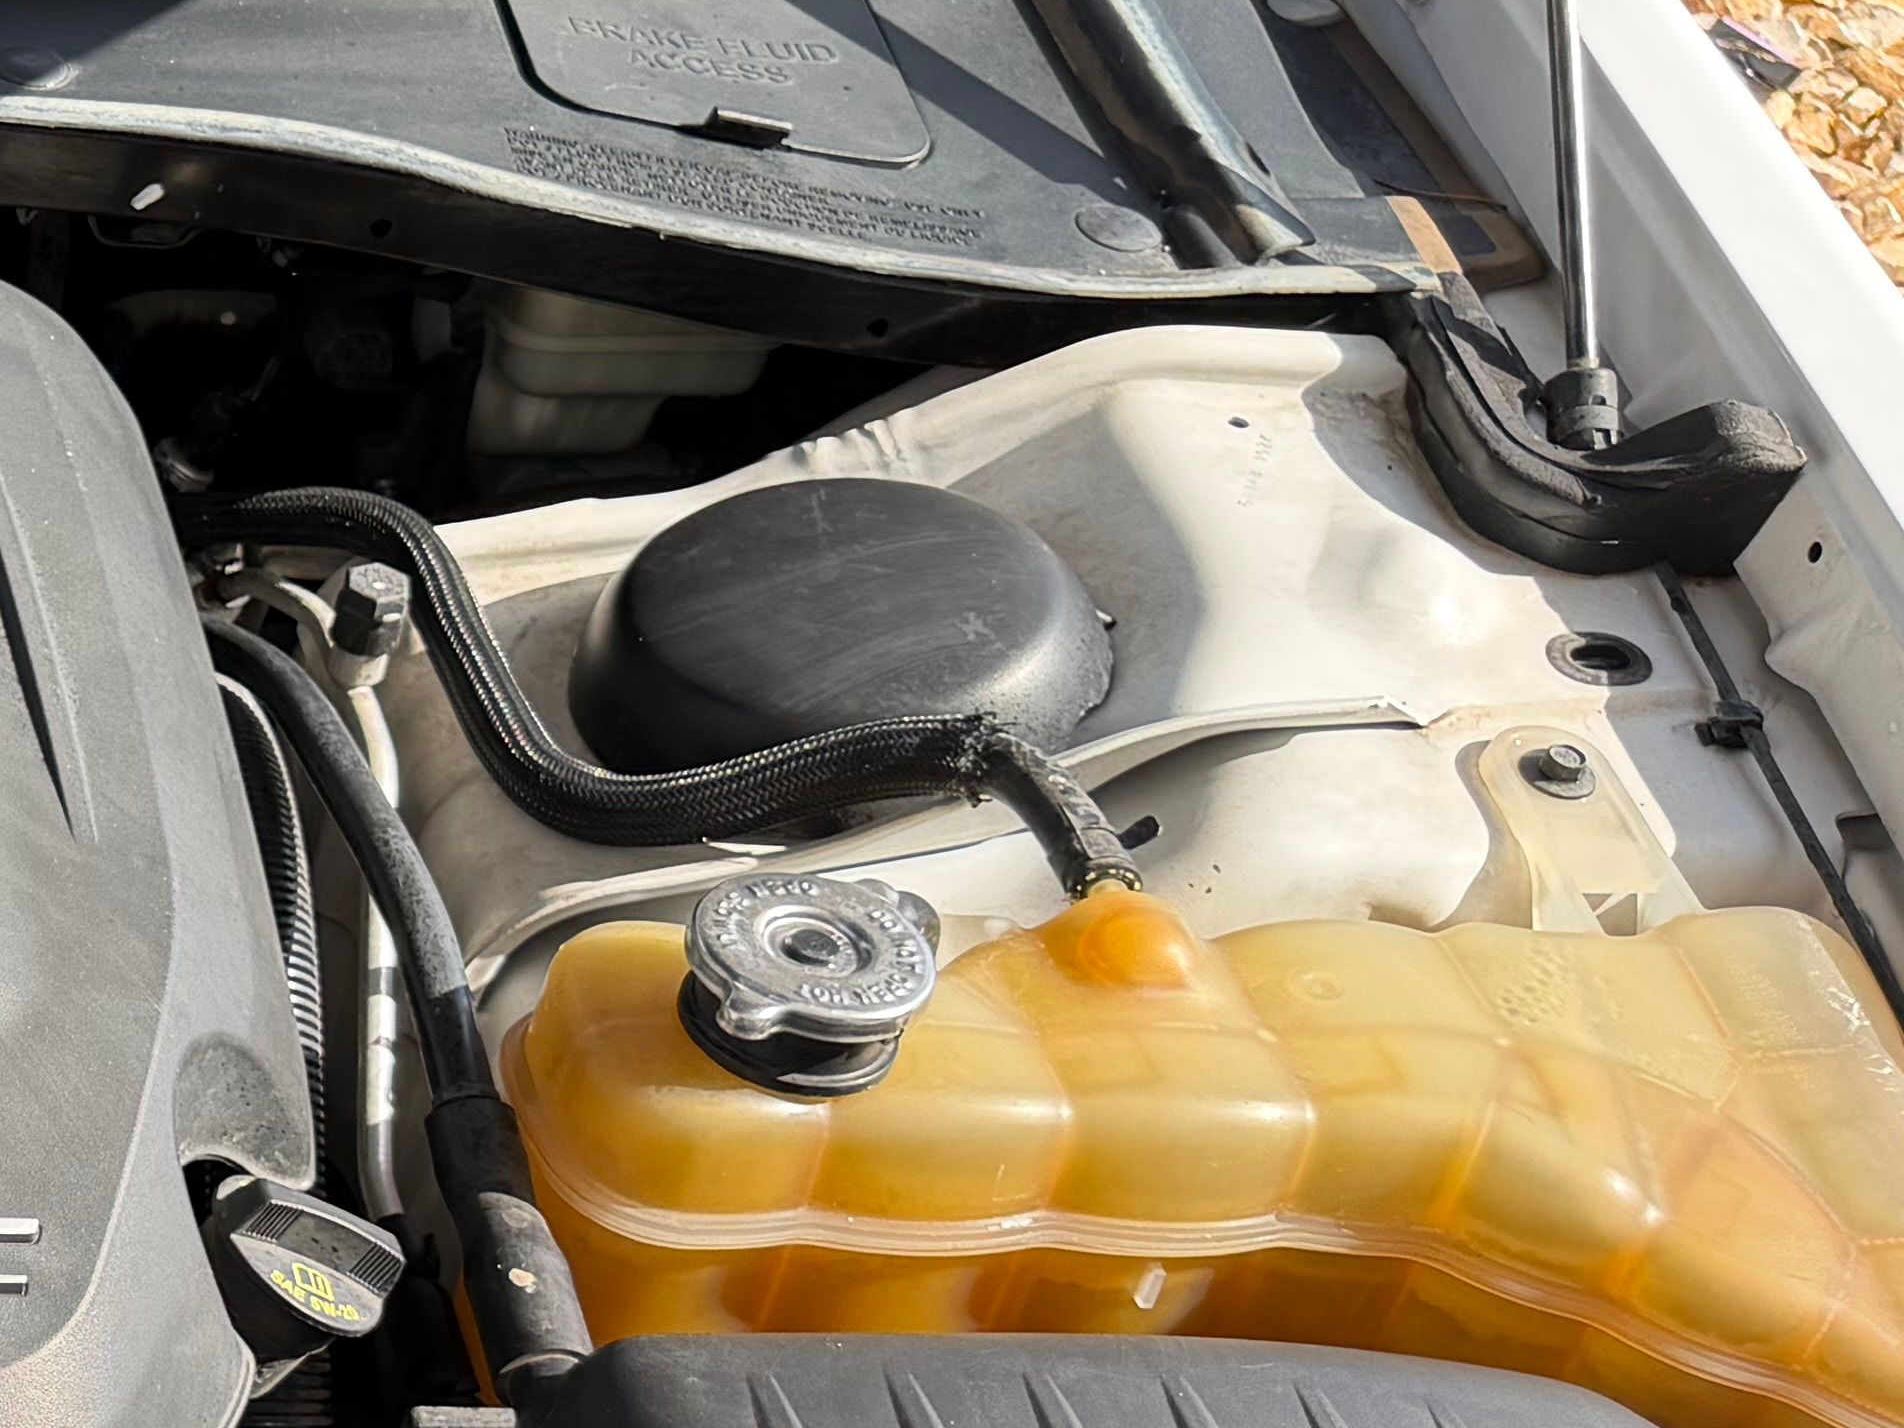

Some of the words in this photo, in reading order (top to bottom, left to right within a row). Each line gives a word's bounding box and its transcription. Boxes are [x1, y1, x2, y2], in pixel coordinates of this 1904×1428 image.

[566, 15, 703, 52] BRAKE
[717, 36, 841, 65] FLUID
[626, 47, 792, 85] ACCESS
[271, 1269, 306, 1303] SAE
[310, 1296, 360, 1321] 5W-20
